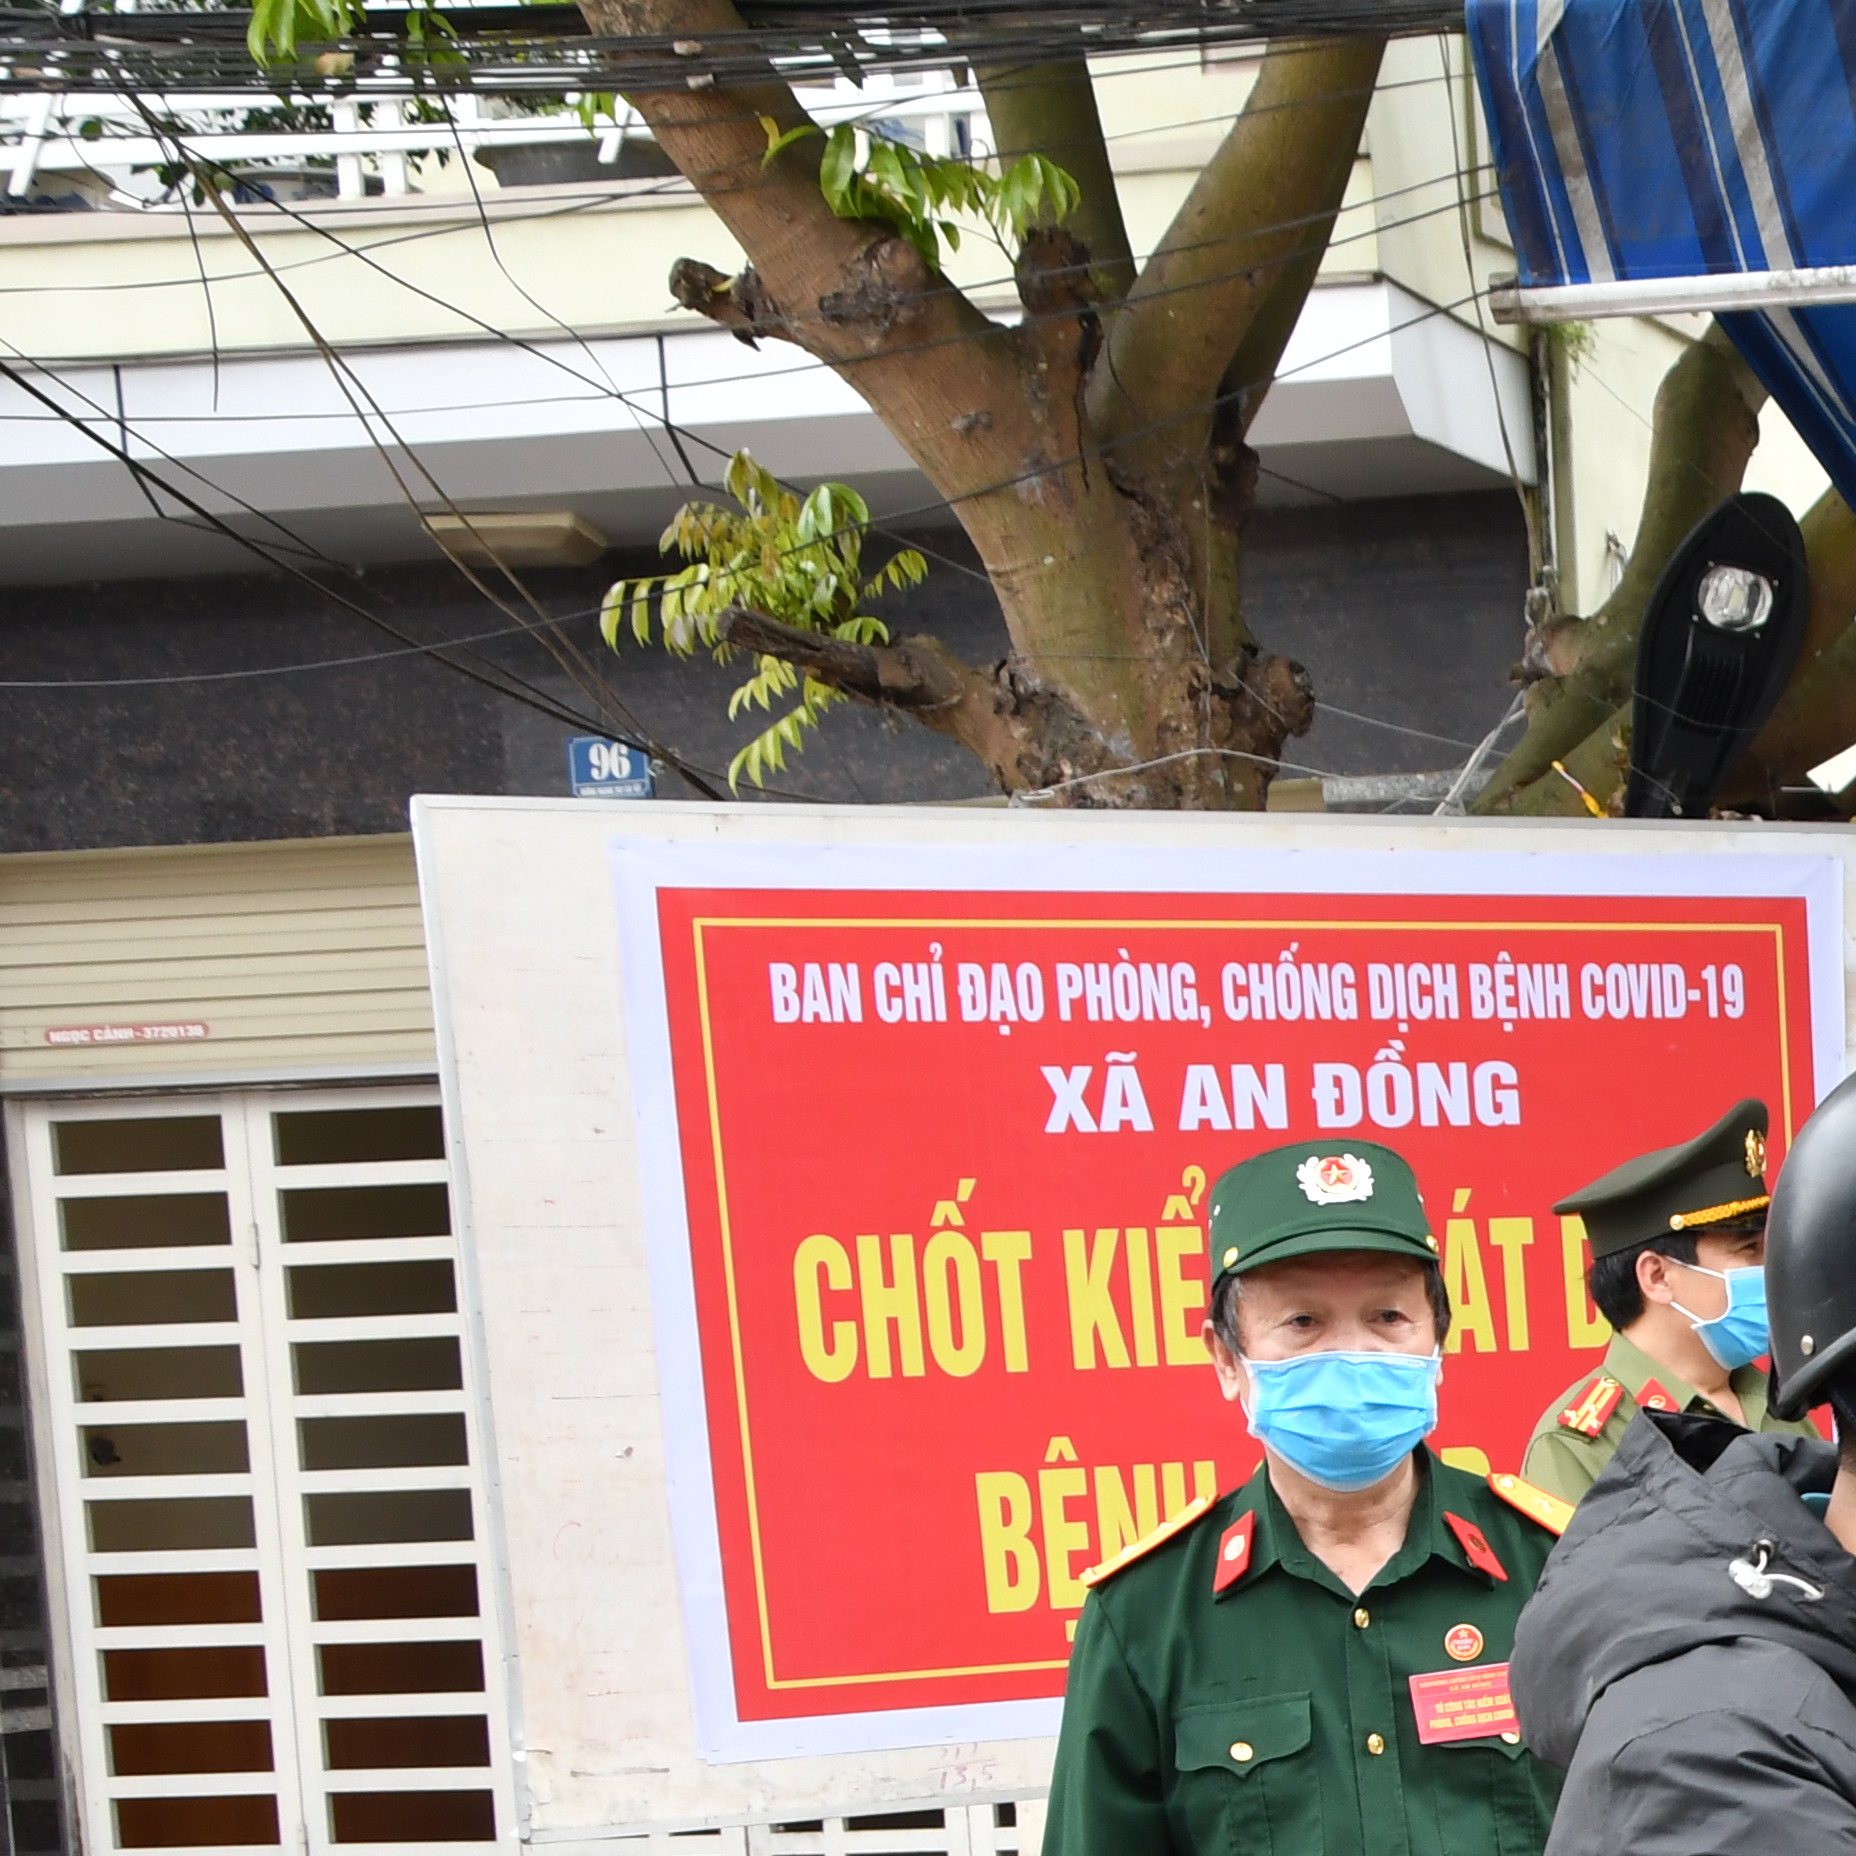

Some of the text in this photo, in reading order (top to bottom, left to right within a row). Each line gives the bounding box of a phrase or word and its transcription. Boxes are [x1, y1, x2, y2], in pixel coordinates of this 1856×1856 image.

[589, 742, 631, 780] 96
[769, 942, 1745, 1036] BAN CHỈ ĐẠO PHÒNG, CHỐNG DỊCH BỆNH COVID-19
[1040, 1039, 1521, 1133] XÃ AN ĐỒNG
[793, 1178, 1032, 1383] CHỐT
[1062, 1165, 1213, 1370] KIỂ
[1443, 1188, 1534, 1354] ÁT
